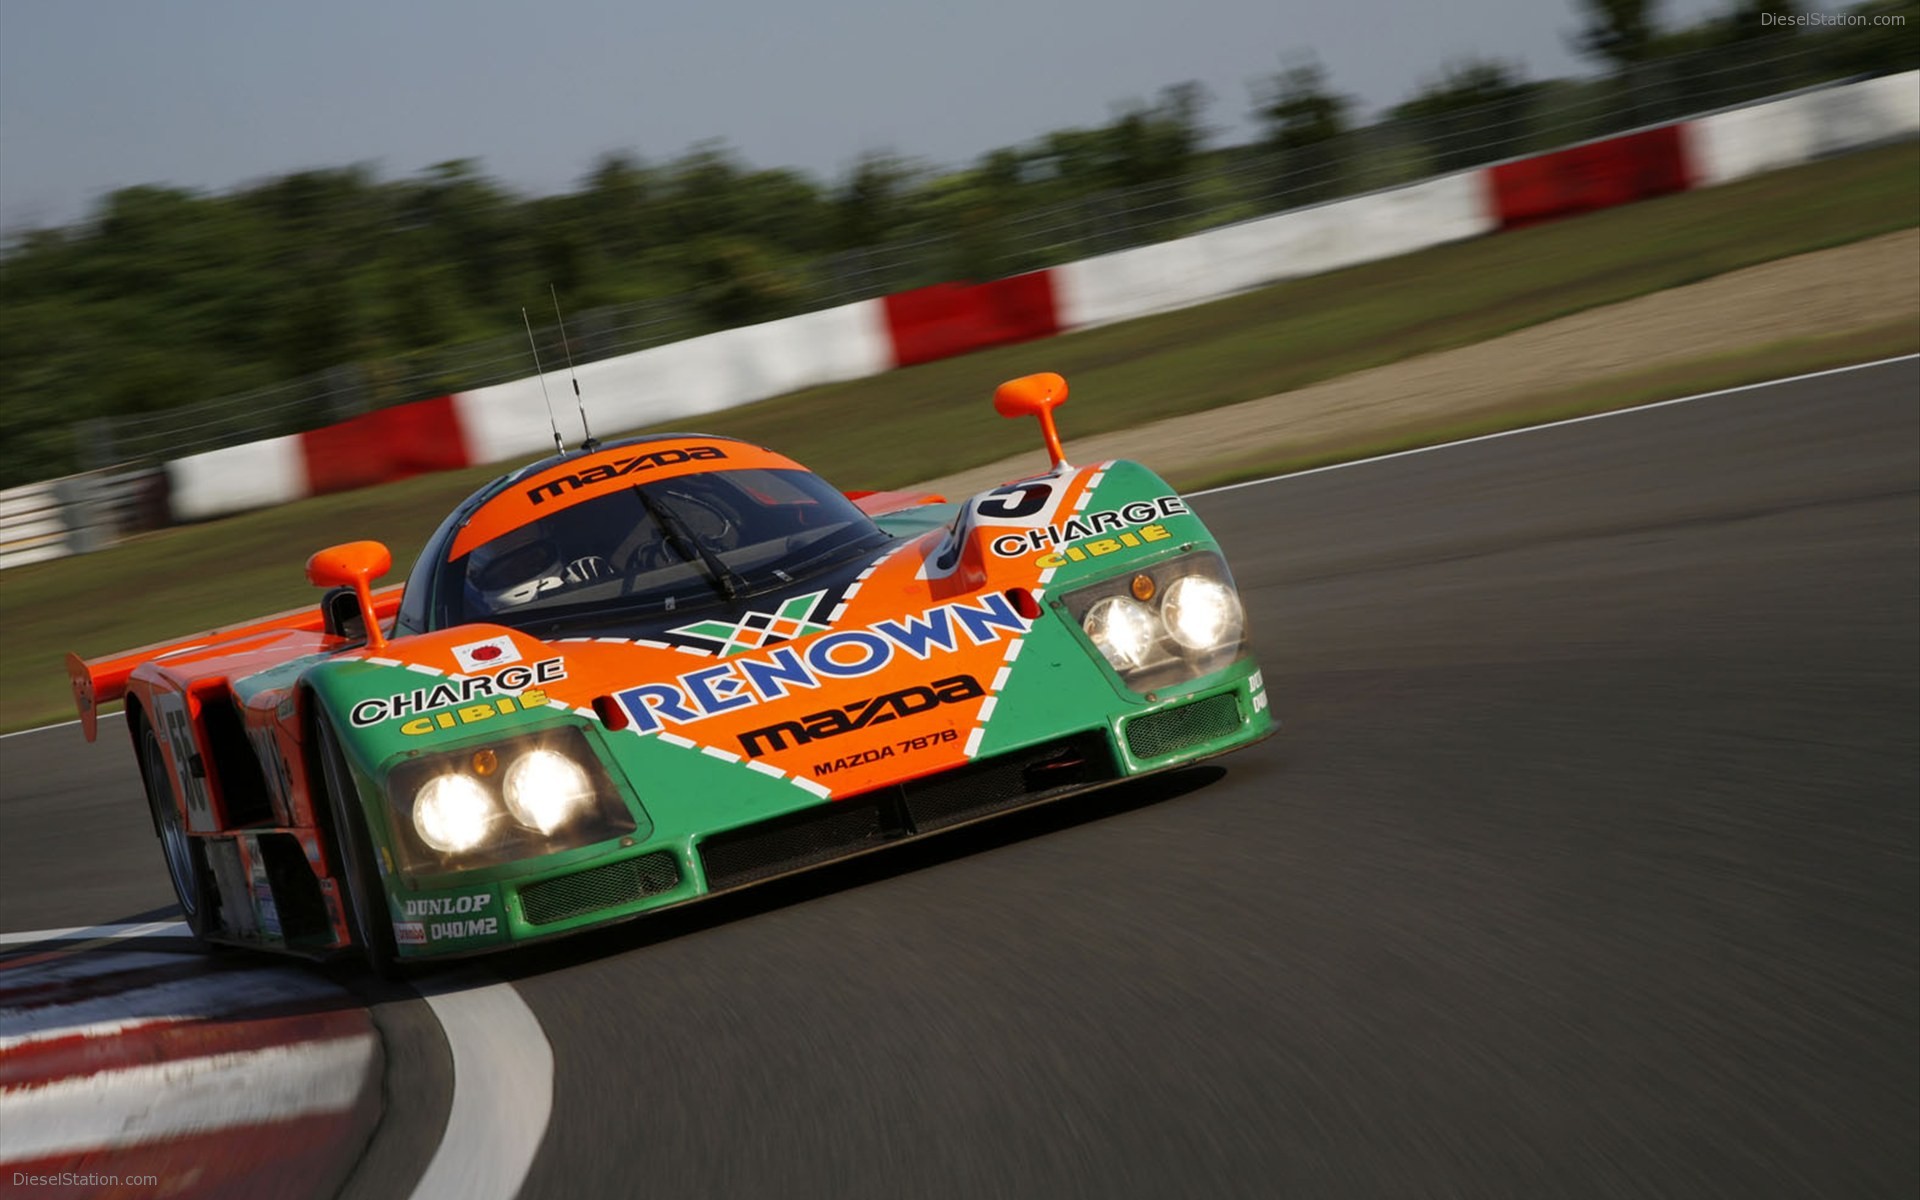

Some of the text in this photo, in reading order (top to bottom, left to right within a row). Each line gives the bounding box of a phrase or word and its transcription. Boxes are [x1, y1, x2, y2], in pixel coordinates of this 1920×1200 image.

[525, 445, 729, 506] mazda
[990, 494, 1192, 559] CHARGE
[350, 656, 569, 729] CHARGE
[612, 591, 1032, 737] RENOWN
[736, 673, 988, 759] mazda
[813, 729, 959, 778] MAZDA 787B
[405, 893, 492, 917] DUNLOP
